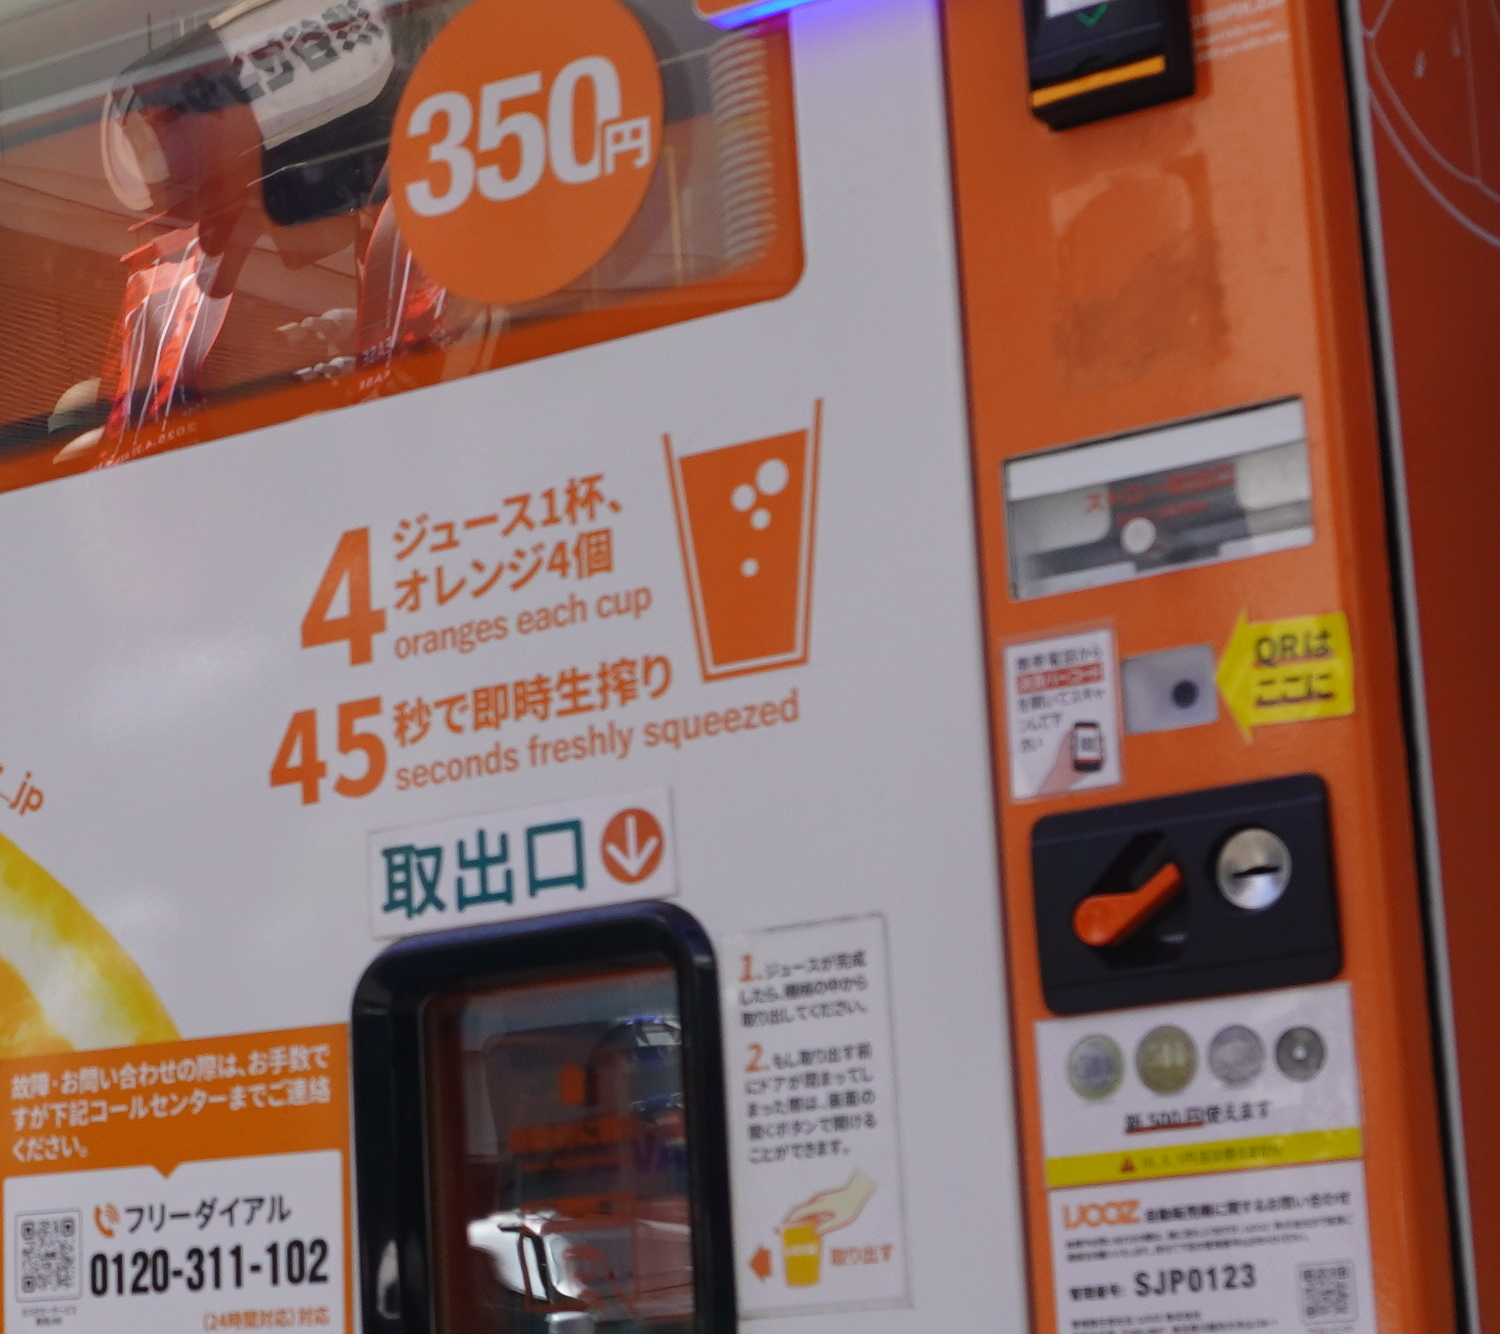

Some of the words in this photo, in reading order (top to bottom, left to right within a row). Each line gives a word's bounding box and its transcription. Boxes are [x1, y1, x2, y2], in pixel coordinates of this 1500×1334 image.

[404, 54, 652, 218] 350円
[392, 474, 623, 561] ジュース1杯、
[301, 526, 387, 667] 4
[392, 527, 615, 615] オレンジ4個
[394, 617, 510, 660] oranges
[517, 593, 587, 637] each
[594, 585, 653, 624] cup
[1255, 628, 1333, 665] QRは
[393, 653, 674, 750] 秒で即時生搾り
[396, 741, 520, 791] seconds
[528, 715, 634, 773] freshly
[643, 687, 801, 750] squeezed
[268, 695, 389, 807] 45
[381, 818, 587, 919] 取出口
[12, 1135, 88, 1163] ください。
[124, 1195, 291, 1234] フリーダイアル
[89, 1238, 329, 1299] 0120-311-102
[1134, 1263, 1256, 1299] SJP0123
